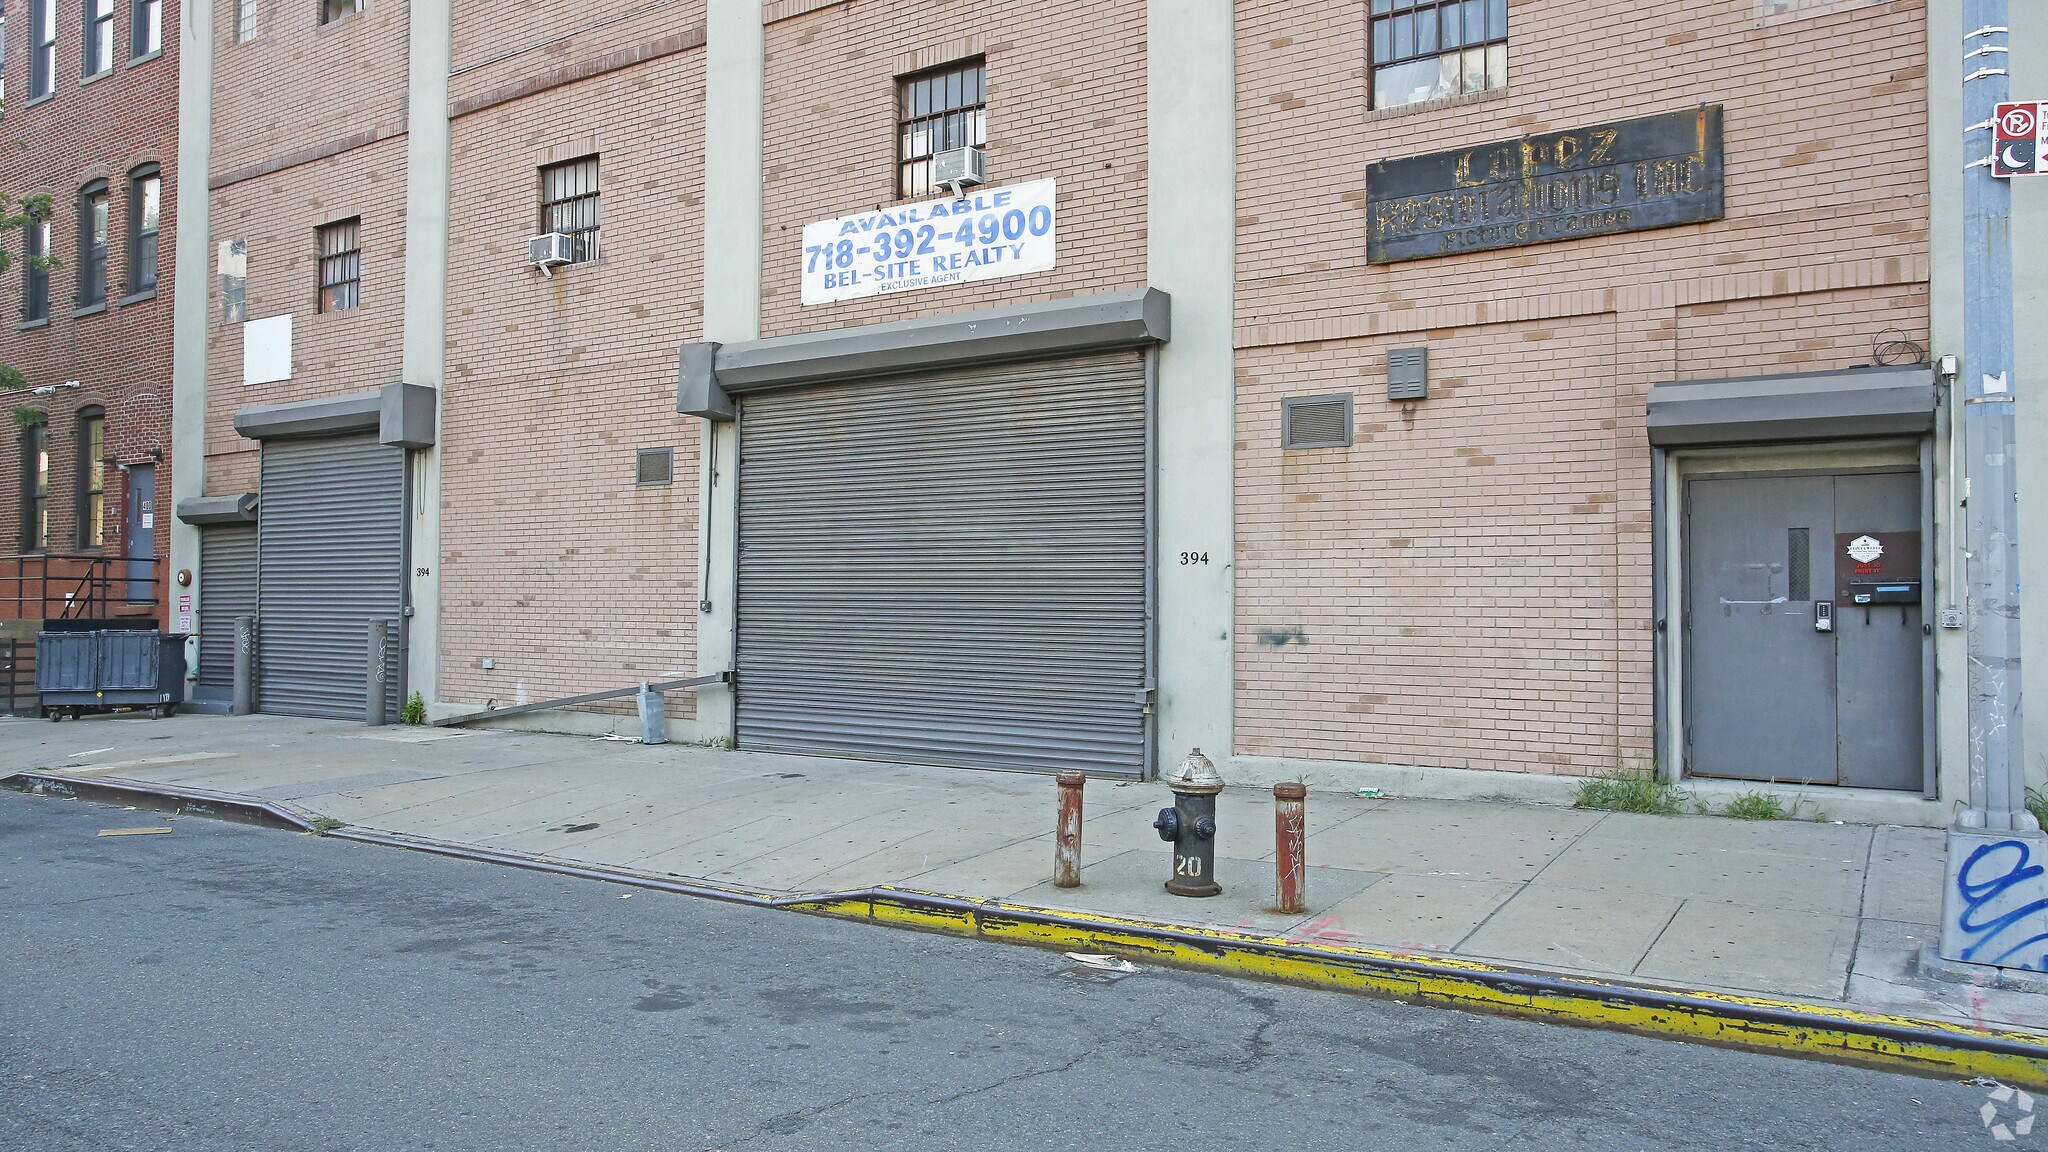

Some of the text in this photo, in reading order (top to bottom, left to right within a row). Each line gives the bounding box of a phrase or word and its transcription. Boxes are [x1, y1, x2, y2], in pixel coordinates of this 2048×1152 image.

[838, 190, 1013, 237] AVAILABLE
[805, 204, 1052, 273] 718-392-4900
[824, 242, 1026, 290] BEL-SITE REALTY
[881, 271, 961, 292] EXCLUSIVE AGENT
[1180, 551, 1210, 566] 394
[416, 566, 430, 577] 394
[1176, 853, 1202, 877] 20
